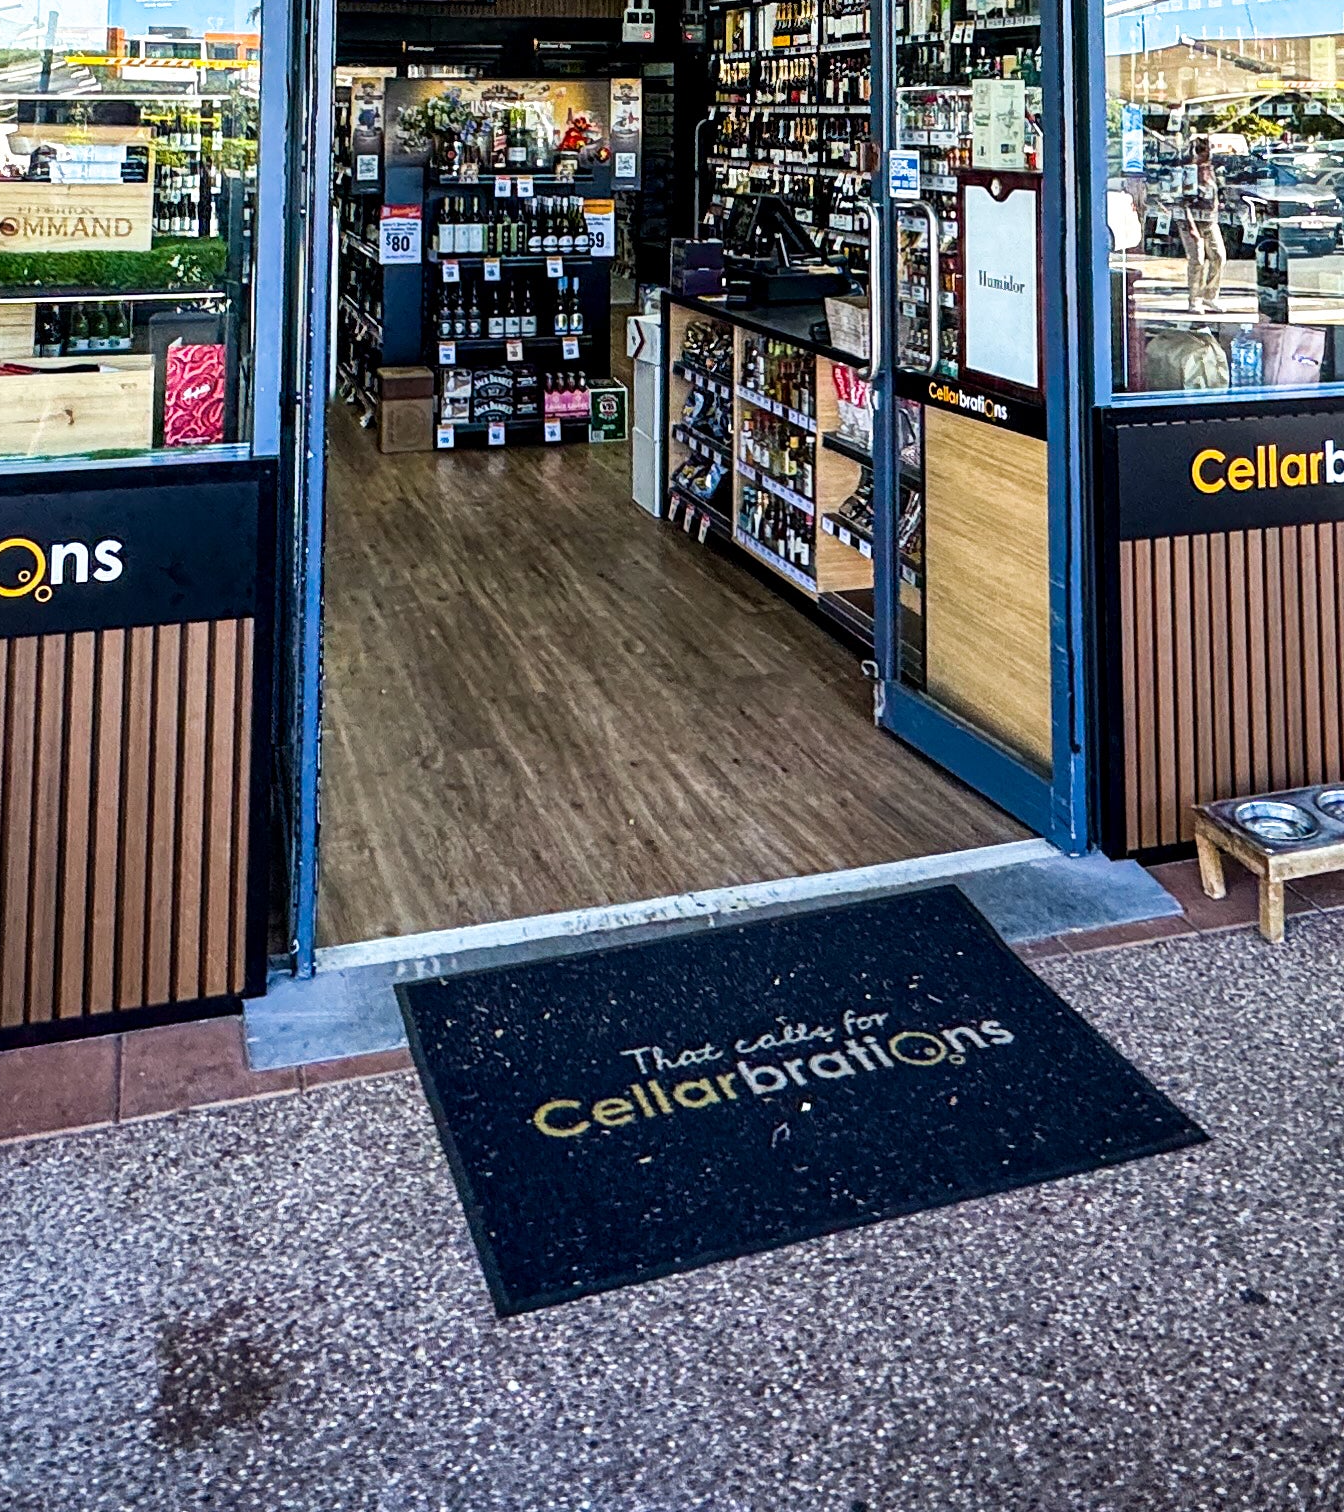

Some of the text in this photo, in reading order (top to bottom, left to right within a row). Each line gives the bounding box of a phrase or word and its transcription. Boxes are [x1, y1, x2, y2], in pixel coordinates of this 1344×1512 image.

[386, 232, 410, 252] $80
[978, 269, 1026, 294] Humidor
[620, 1044, 724, 1075] That
[843, 1009, 890, 1036] for
